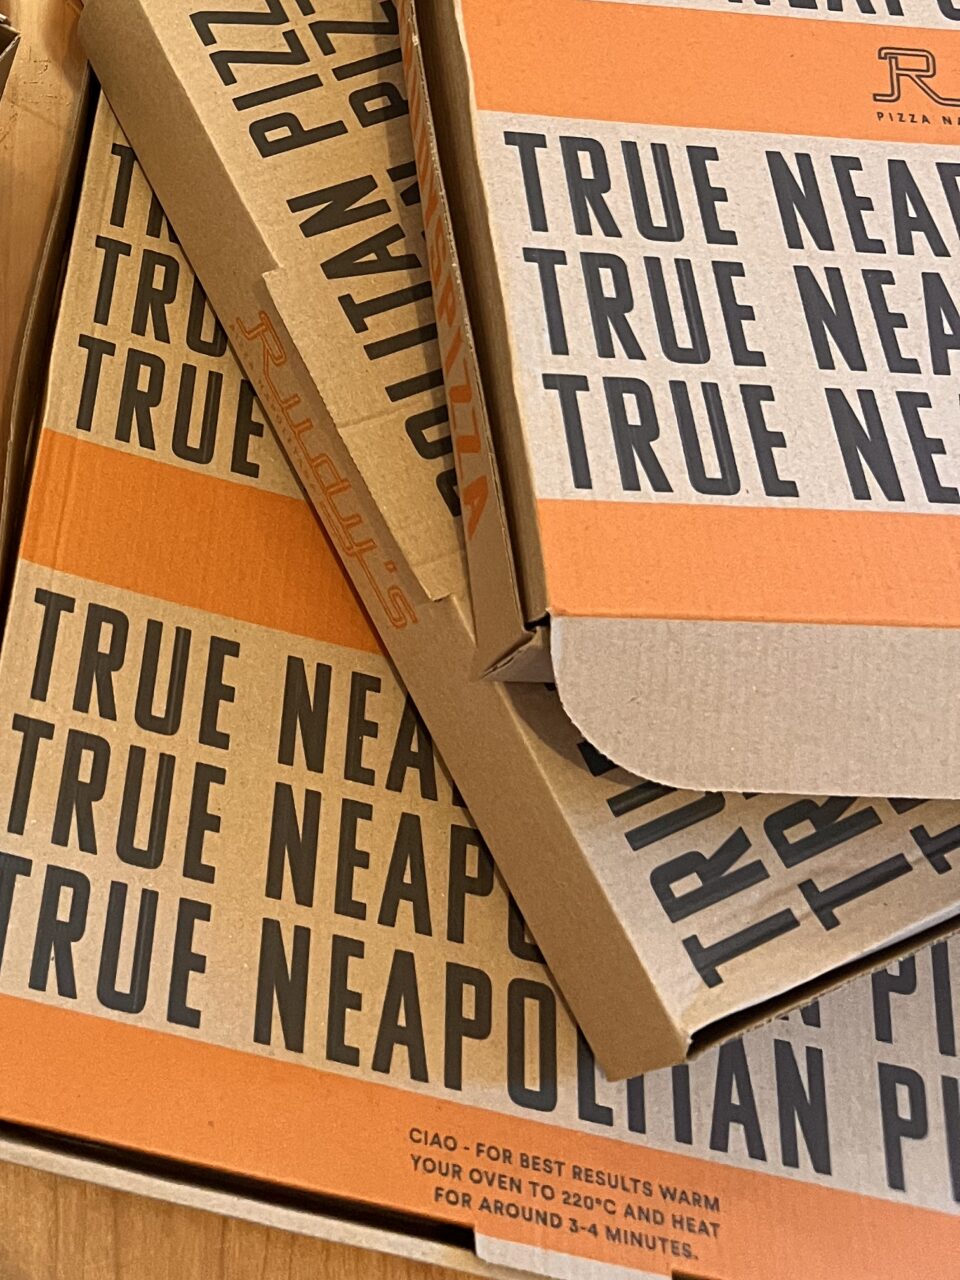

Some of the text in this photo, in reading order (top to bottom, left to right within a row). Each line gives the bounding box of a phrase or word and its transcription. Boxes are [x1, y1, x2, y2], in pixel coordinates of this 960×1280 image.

[876, 111, 931, 125] PIZZA
[503, 130, 739, 247] TRUE
[522, 246, 768, 369] TRUE
[75, 333, 265, 480] TRUE
[542, 373, 800, 500] TRUE
[29, 587, 241, 751] TRUE
[6, 712, 227, 885] TRUE
[408, 1126, 459, 1153] CIAO
[476, 1141, 513, 1166] FOR
[519, 1152, 566, 1178] BEST
[572, 1164, 653, 1198] RESULTS
[657, 1183, 721, 1213] WARM
[410, 1153, 462, 1182] YOUR
[468, 1166, 523, 1194] OVEN
[528, 1179, 556, 1201] TO
[623, 1203, 665, 1227] AND
[671, 1213, 721, 1239] HEAT
[434, 1186, 700, 1261] FOR AROUND 3-4 MINUTES.
